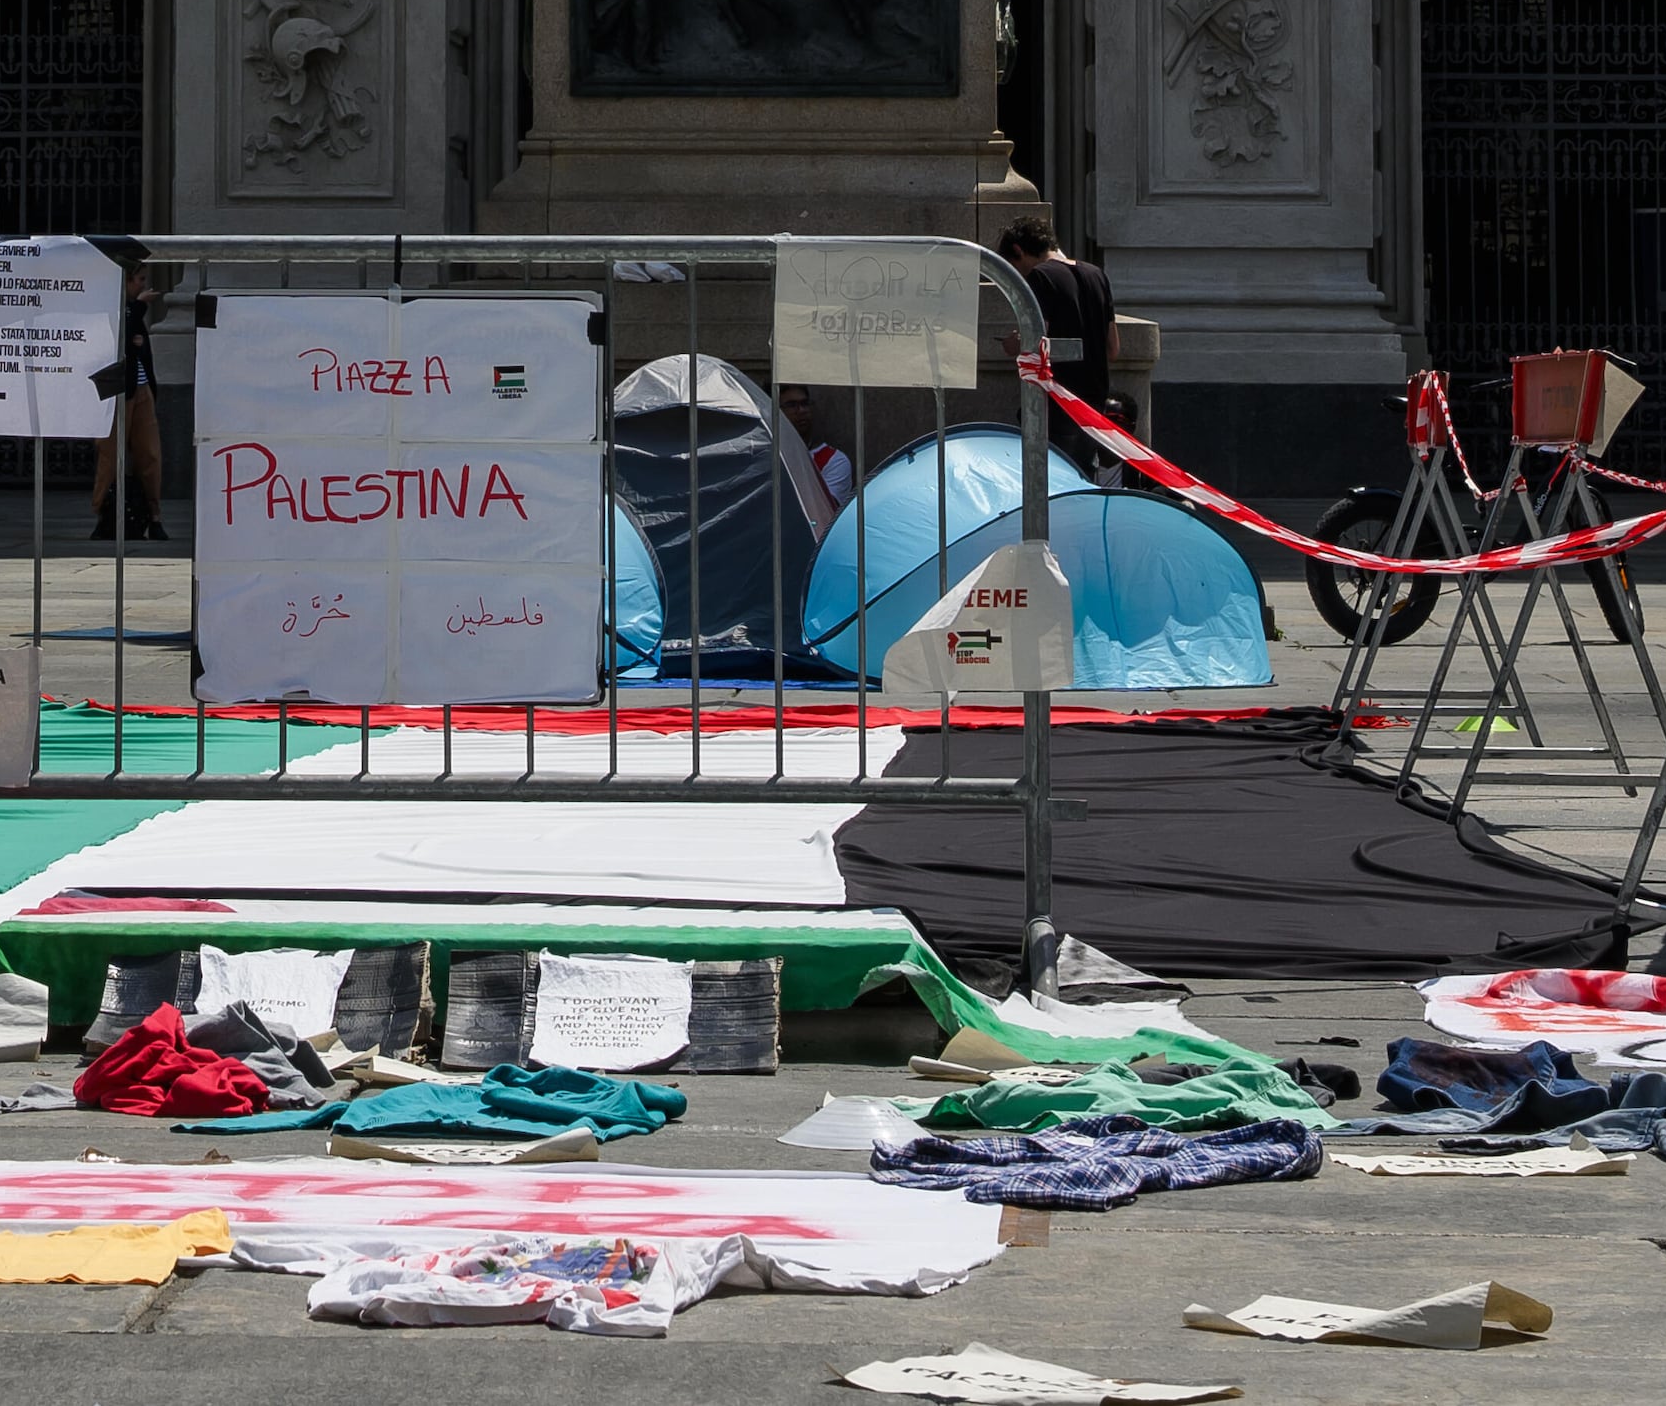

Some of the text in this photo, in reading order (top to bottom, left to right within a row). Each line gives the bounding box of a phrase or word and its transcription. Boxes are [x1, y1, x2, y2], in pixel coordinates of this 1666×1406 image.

[28, 247, 41, 257] PIÙ
[924, 263, 963, 291] LA
[4, 279, 13, 290] LO
[15, 280, 51, 291] FACCIATE
[54, 281, 58, 292] A
[1, 329, 24, 340] STATA
[28, 330, 49, 341] TOLTA
[52, 330, 61, 341] LA
[15, 346, 21, 357] IL
[24, 346, 39, 357] SUO
[41, 347, 61, 358] PESO
[298, 348, 451, 396] PIAZZA
[213, 442, 528, 525] PALESTINA
[446, 596, 544, 635] فلسطين
[956, 656, 990, 664] GENOCIDE
[259, 998, 307, 1008] FERMO
[573, 998, 613, 1006] DON'T
[619, 998, 660, 1006] WANT
